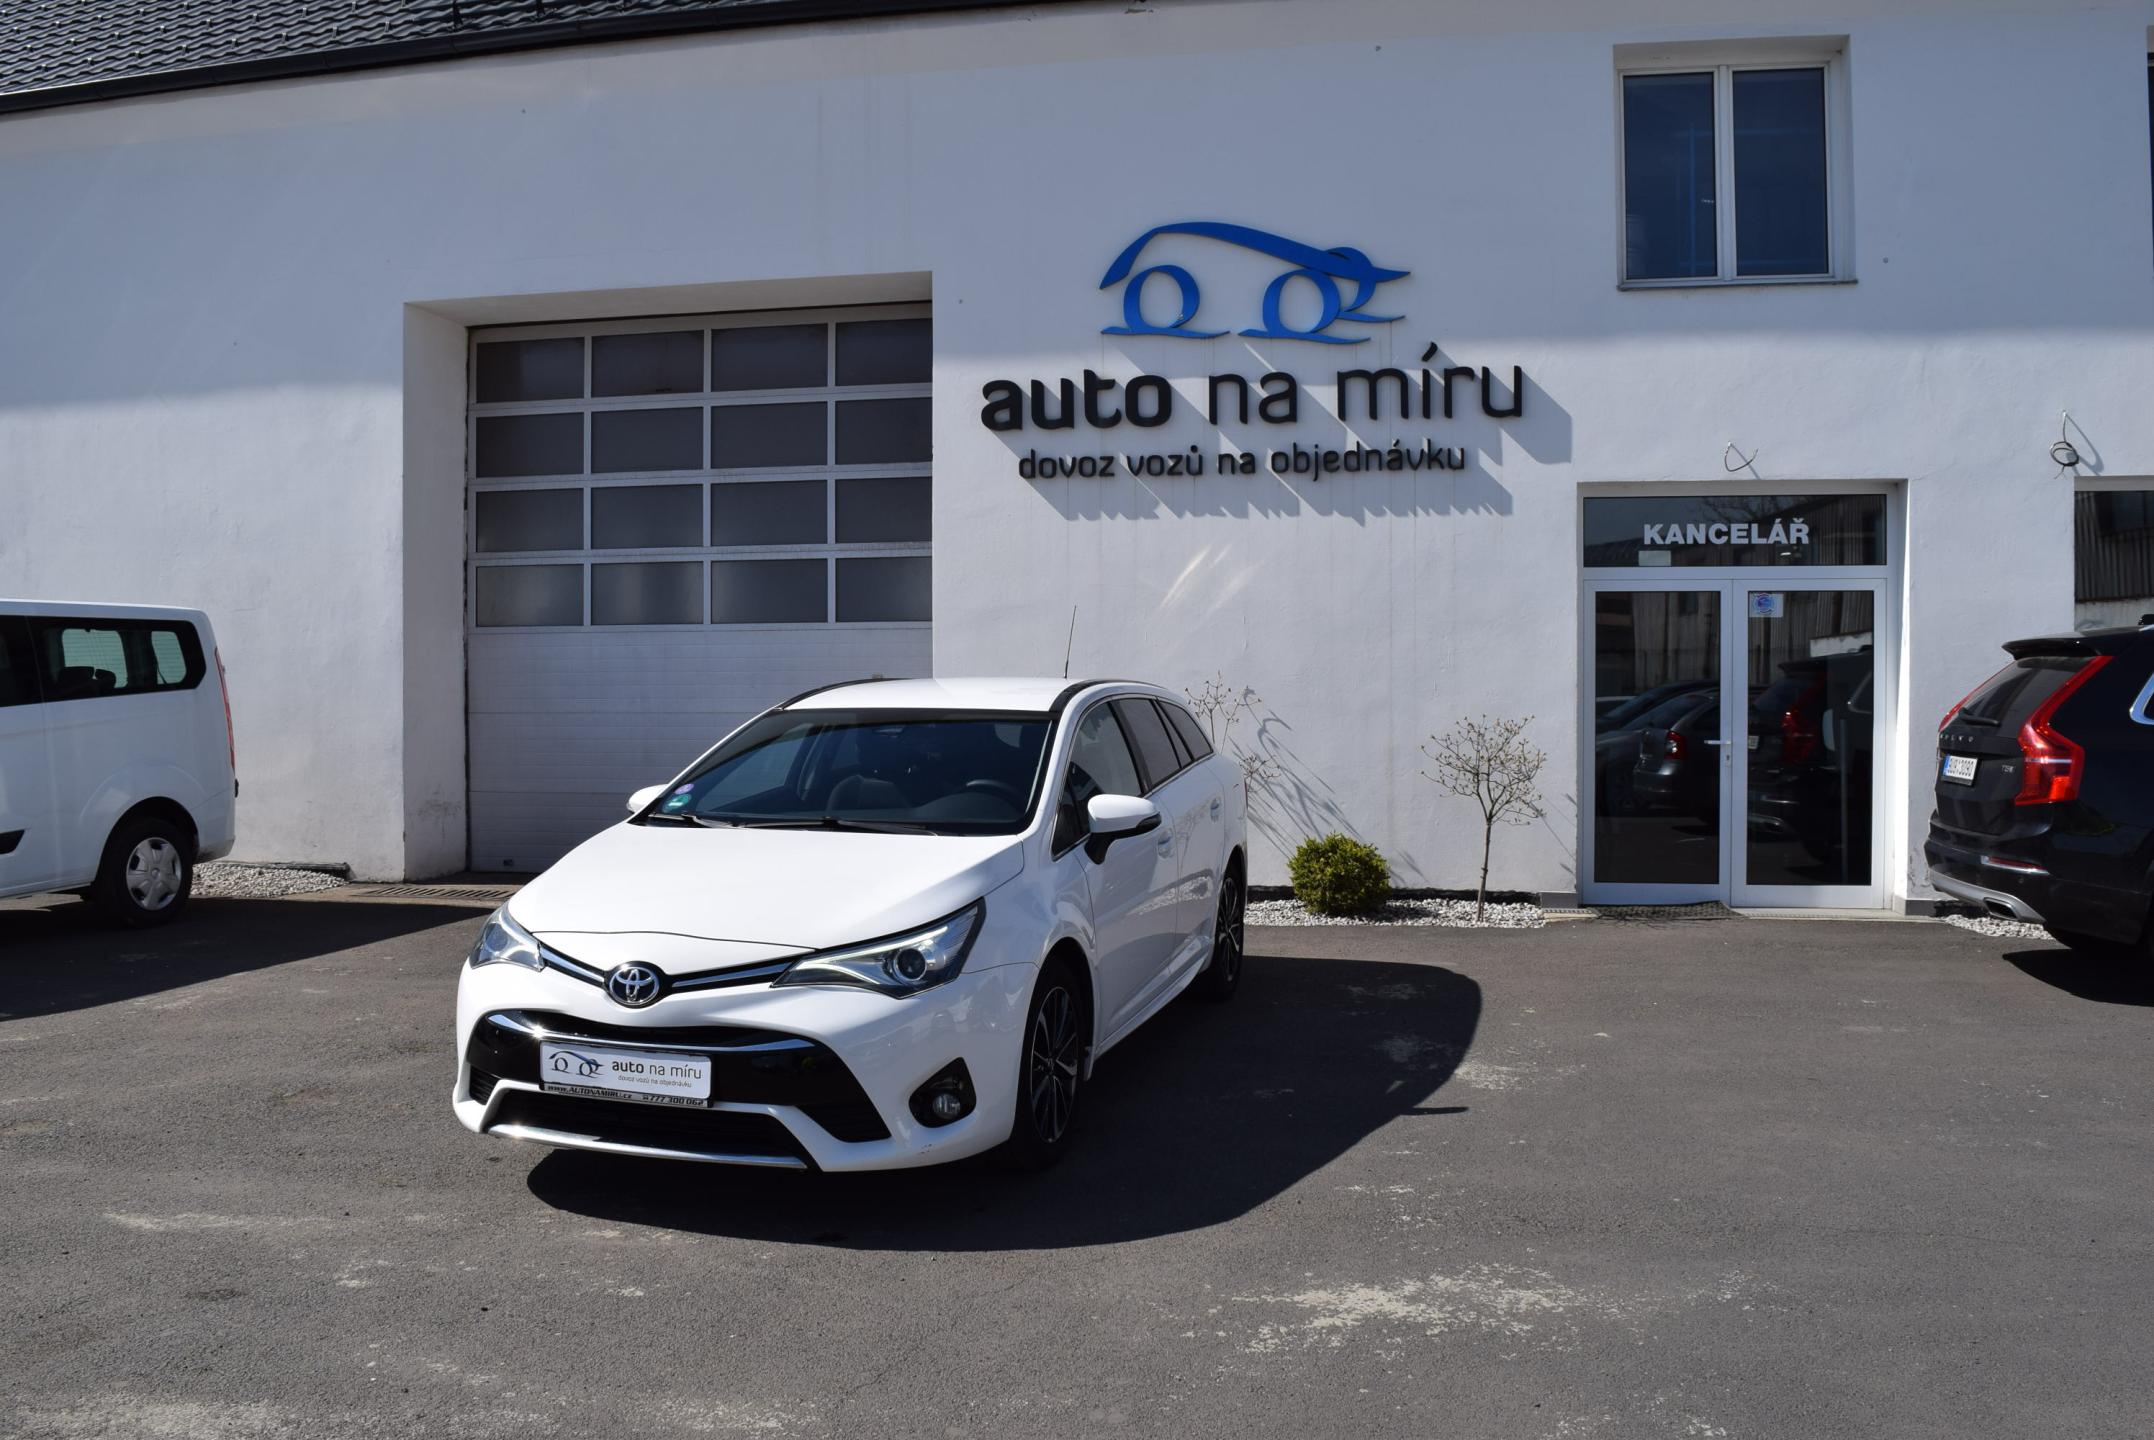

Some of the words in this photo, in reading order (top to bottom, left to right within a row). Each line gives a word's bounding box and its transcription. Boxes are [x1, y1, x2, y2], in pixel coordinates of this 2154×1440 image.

[981, 369, 1172, 431] auto
[1209, 371, 1298, 425] na
[1337, 342, 1522, 421] míru
[1019, 449, 1114, 480] dovoz
[1127, 445, 1204, 477] vozů
[1217, 451, 1256, 475] na
[1271, 440, 1466, 481] objednávku
[1644, 518, 1810, 545] KANCELÁŘ
[612, 1061, 644, 1074] auto
[649, 1064, 665, 1076] na
[670, 1064, 702, 1079] míru
